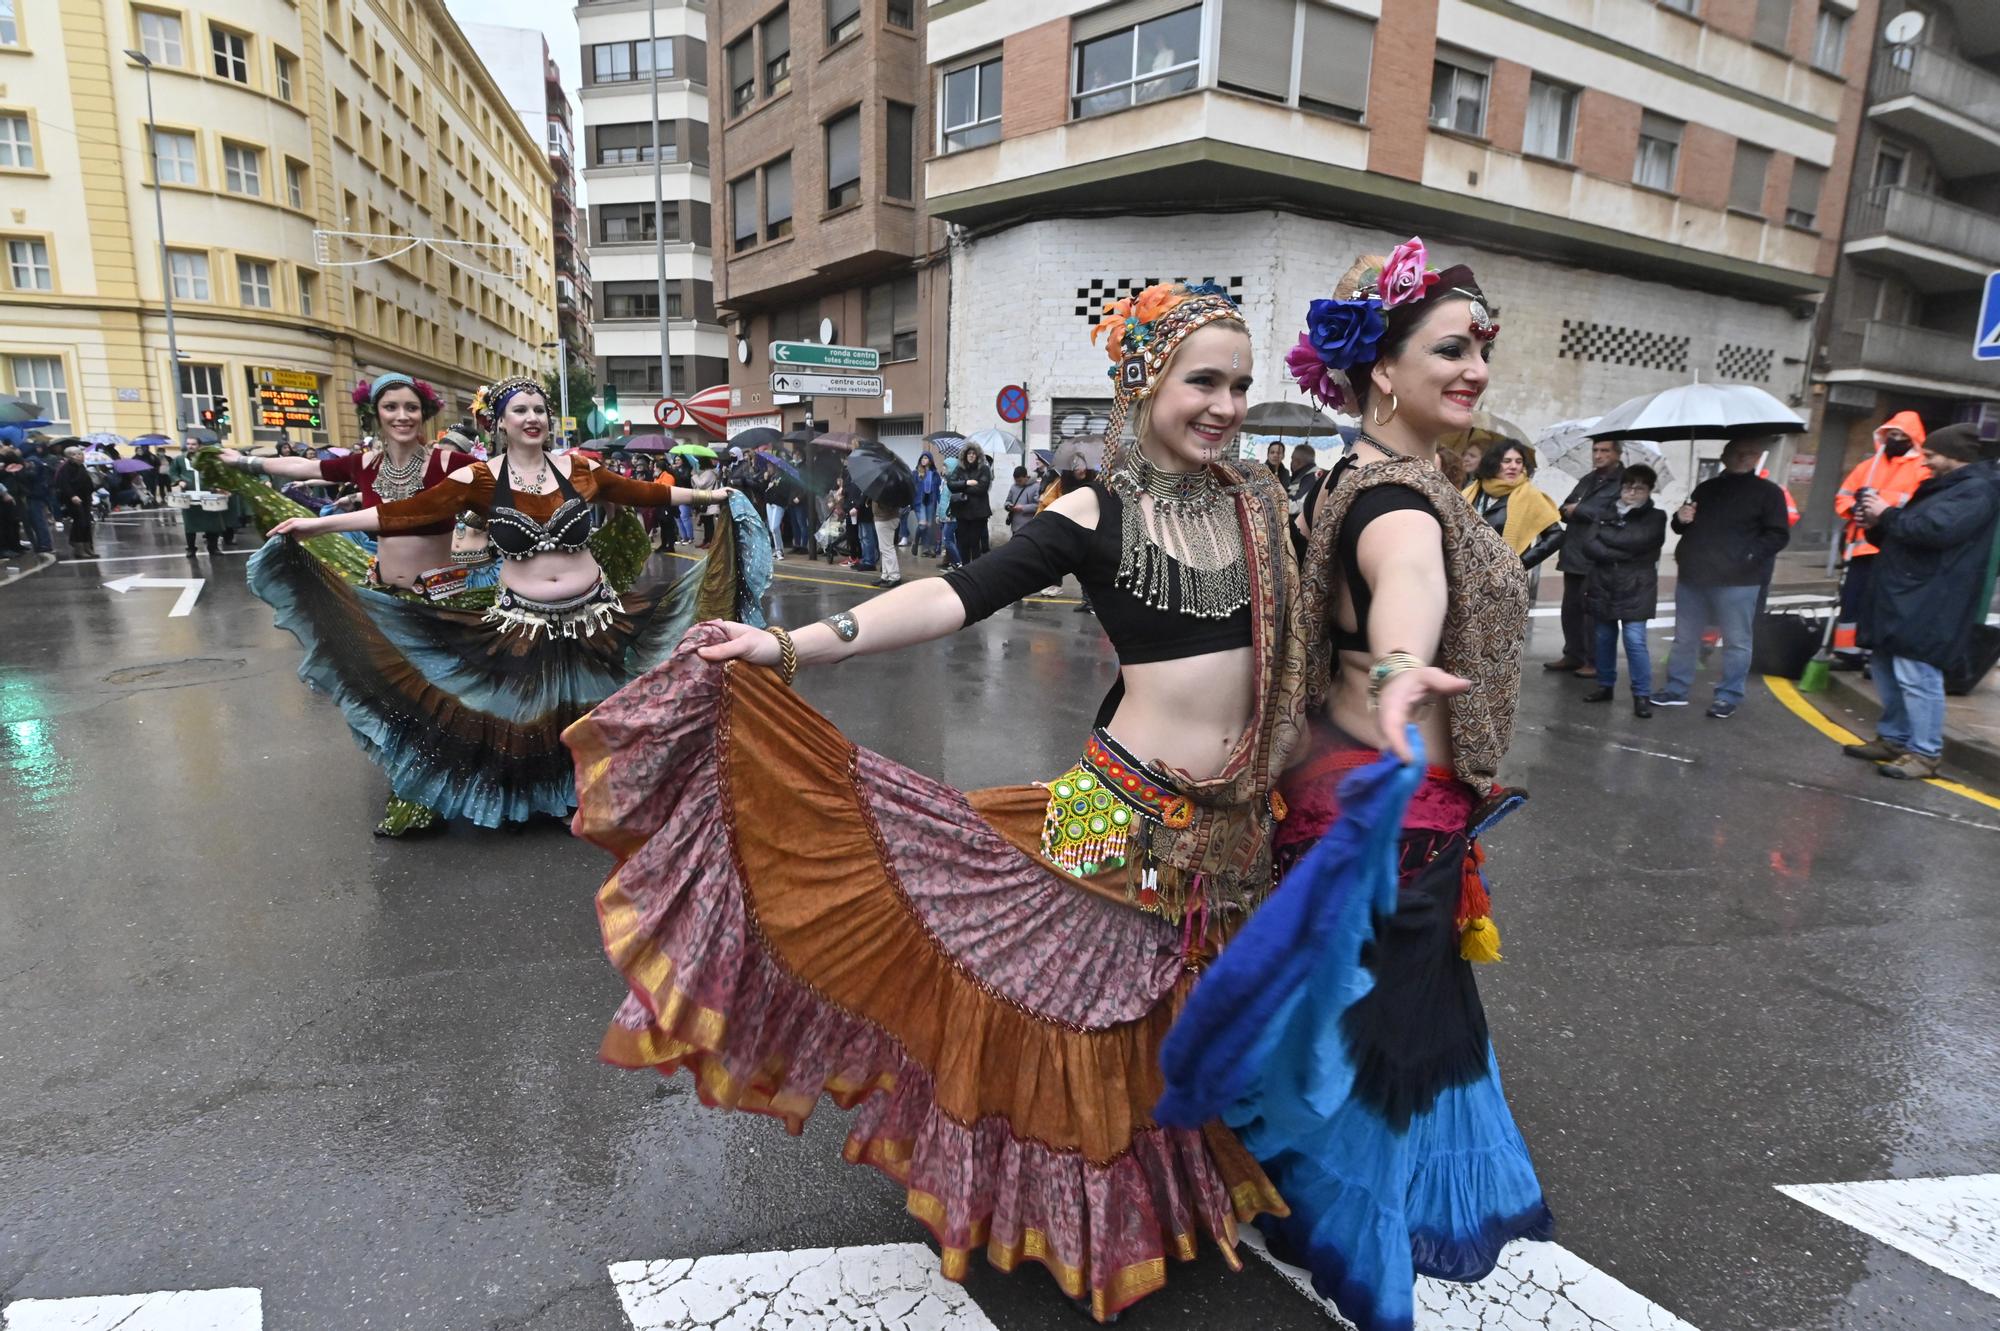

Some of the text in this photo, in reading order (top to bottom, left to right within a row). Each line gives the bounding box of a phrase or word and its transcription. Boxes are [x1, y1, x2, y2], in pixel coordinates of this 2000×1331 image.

[830, 348, 876, 359] ronda centre
[844, 358, 876, 366] direccions
